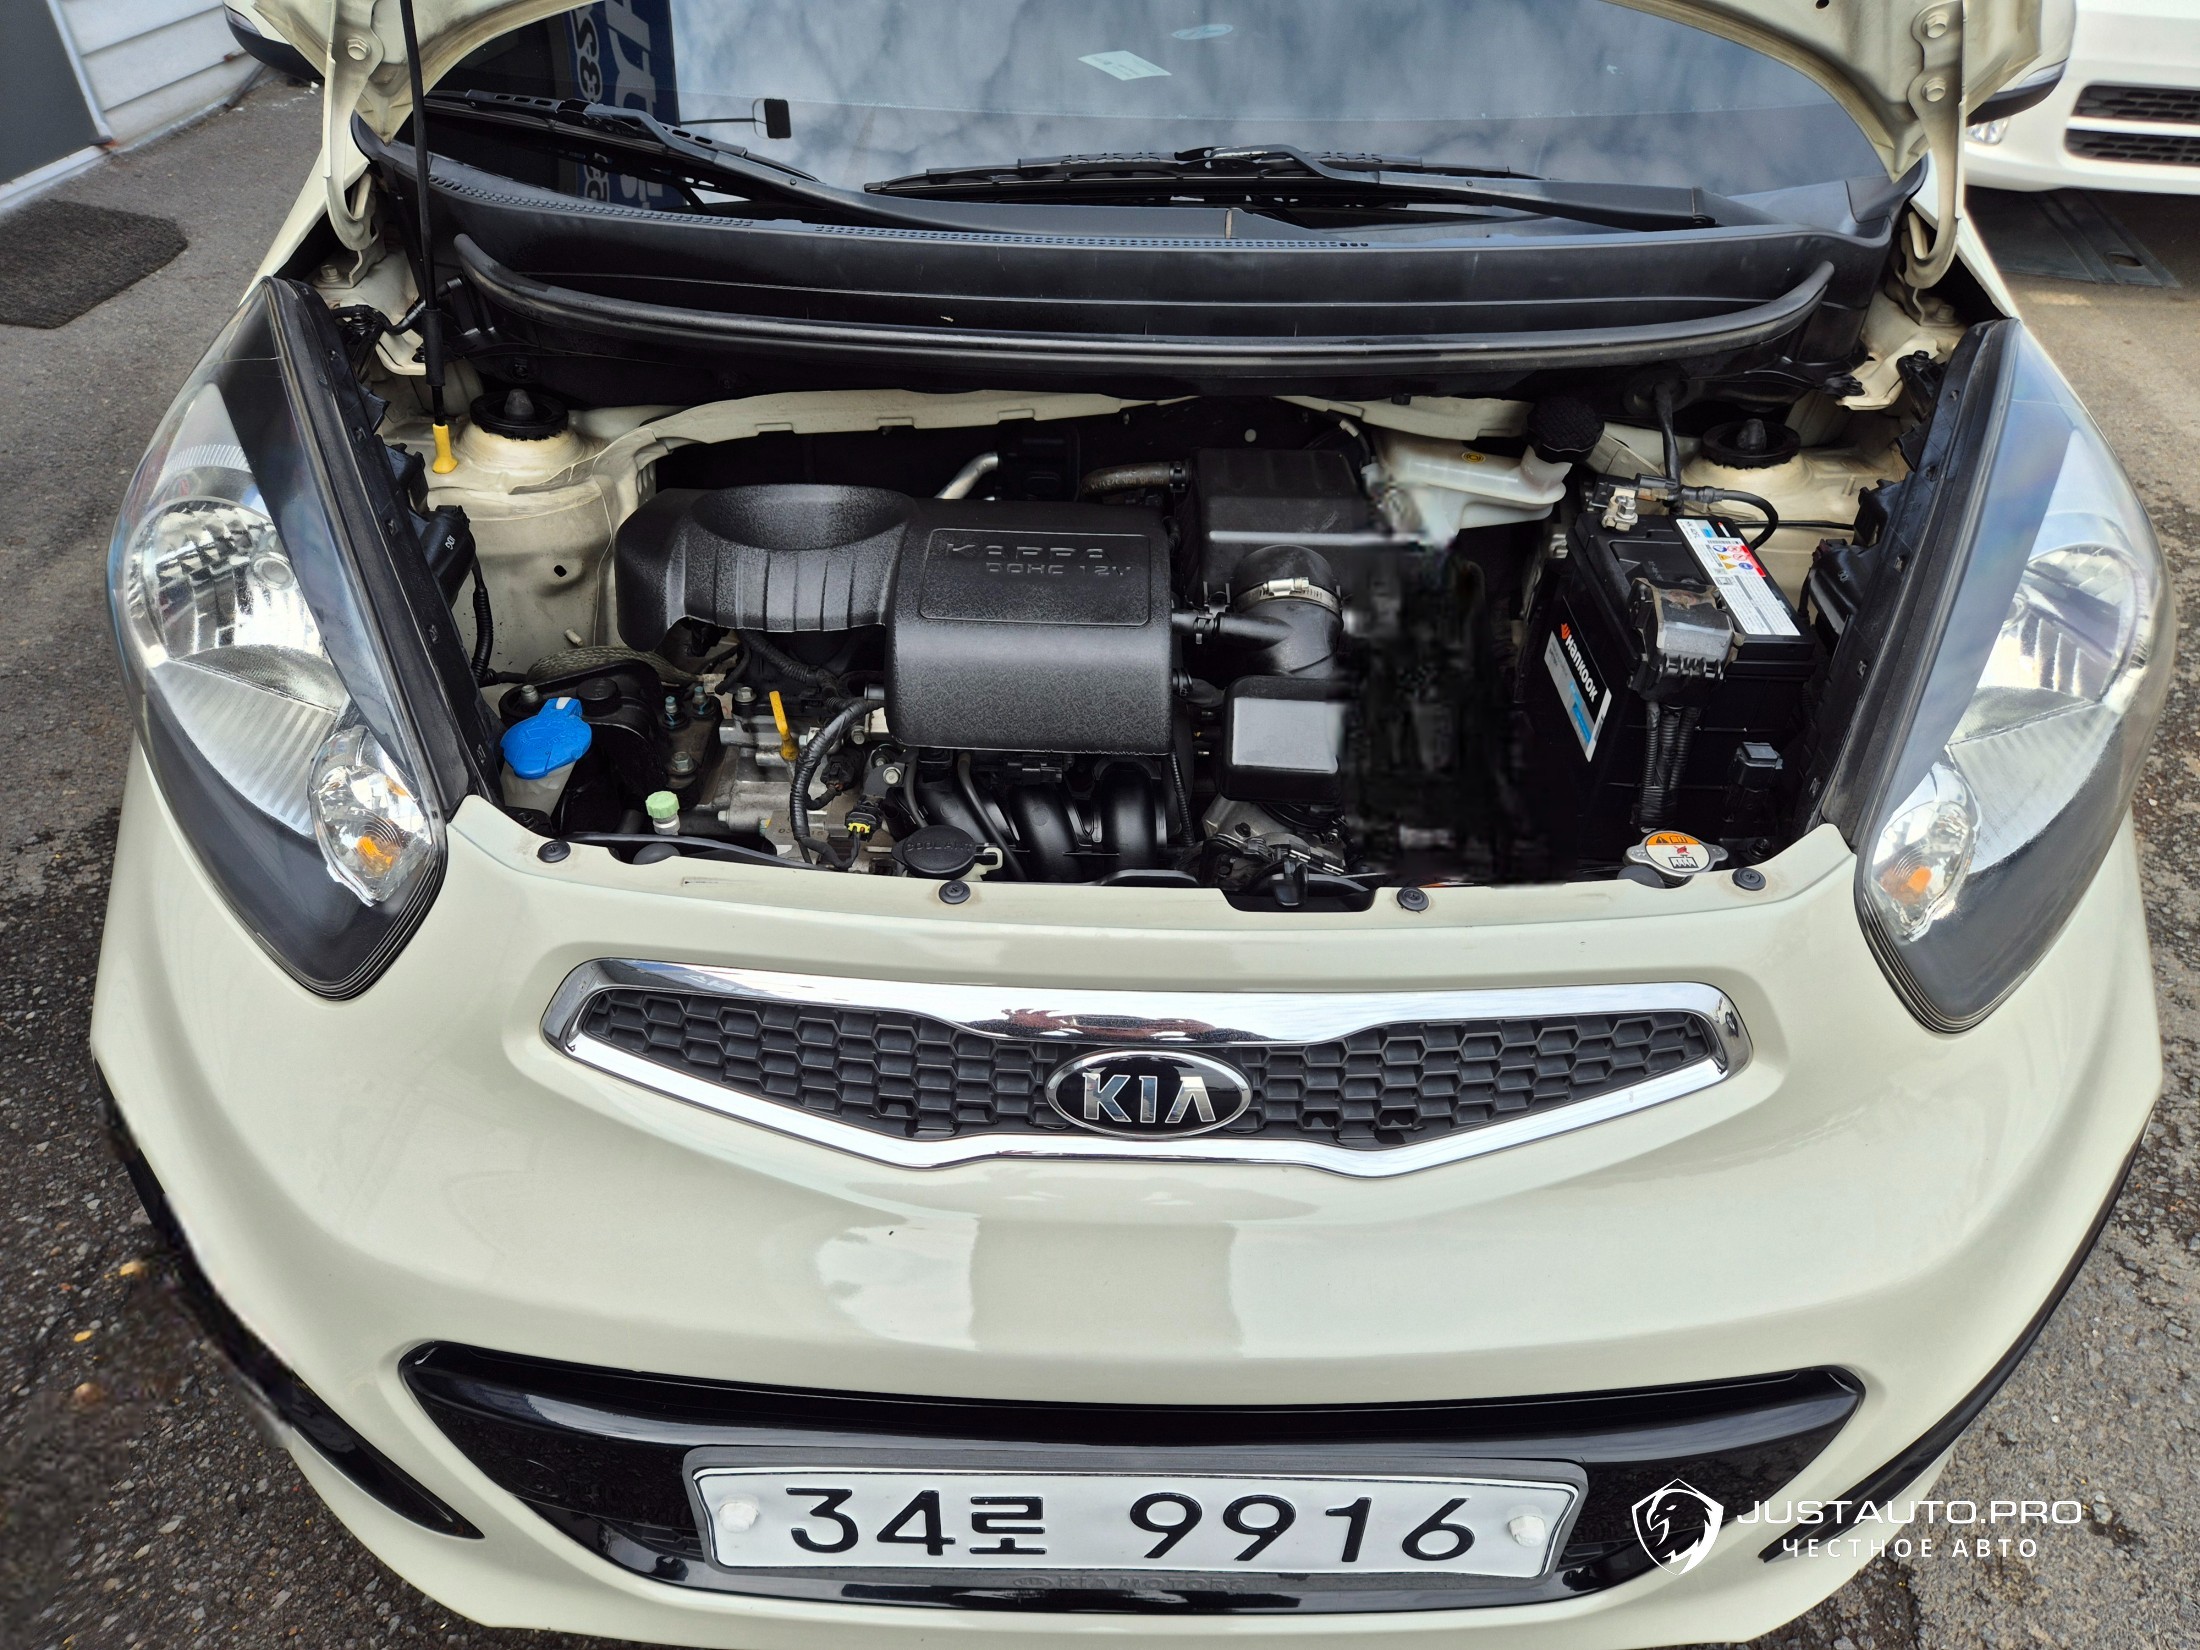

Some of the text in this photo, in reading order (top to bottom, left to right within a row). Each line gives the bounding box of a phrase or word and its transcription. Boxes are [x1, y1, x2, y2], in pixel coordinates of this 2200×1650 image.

[946, 543, 1112, 560] KAPPA
[985, 562, 1132, 577] DOHC 12V
[1083, 1073, 1216, 1123] KIA
[787, 1487, 1476, 1562] 34로 9916
